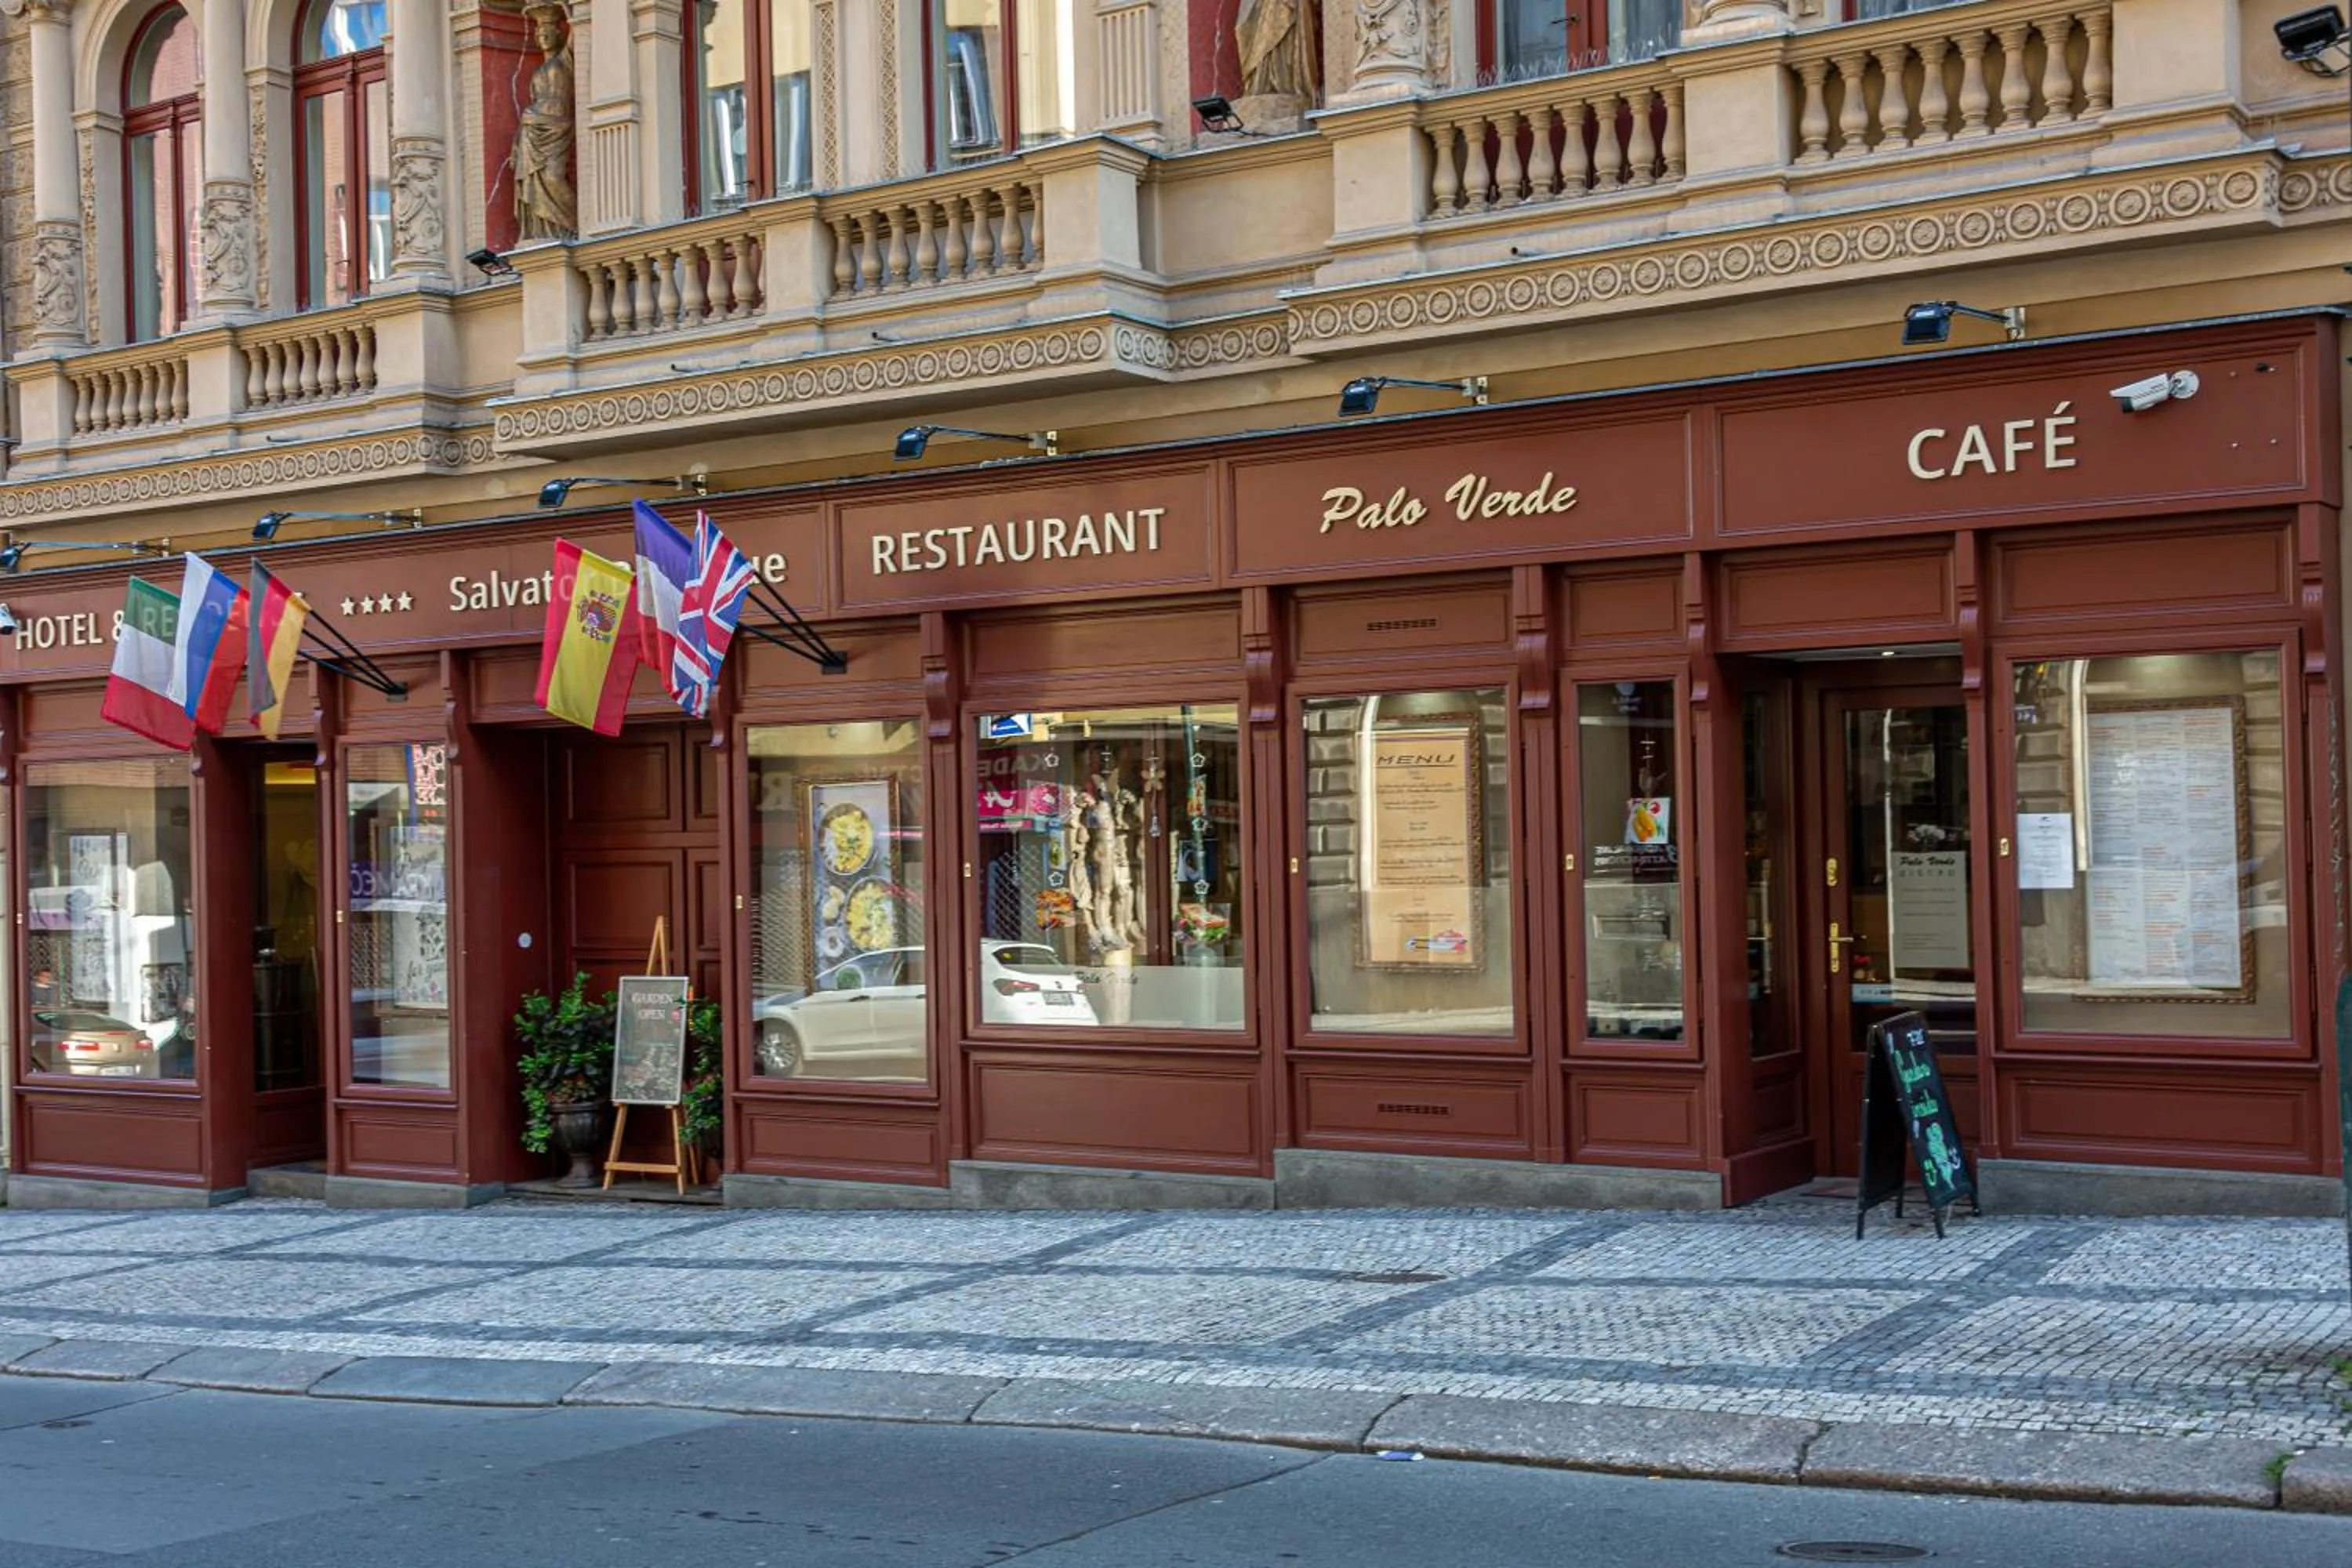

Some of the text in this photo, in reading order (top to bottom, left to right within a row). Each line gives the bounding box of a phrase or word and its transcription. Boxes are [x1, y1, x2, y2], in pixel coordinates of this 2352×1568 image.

[1907, 400, 2077, 479] CAFÉ
[1319, 472, 1577, 534] Palo Verde
[872, 507, 1165, 575] RESTAURANT
[16, 612, 103, 650] HOTEL
[1377, 753, 1456, 766] MENU
